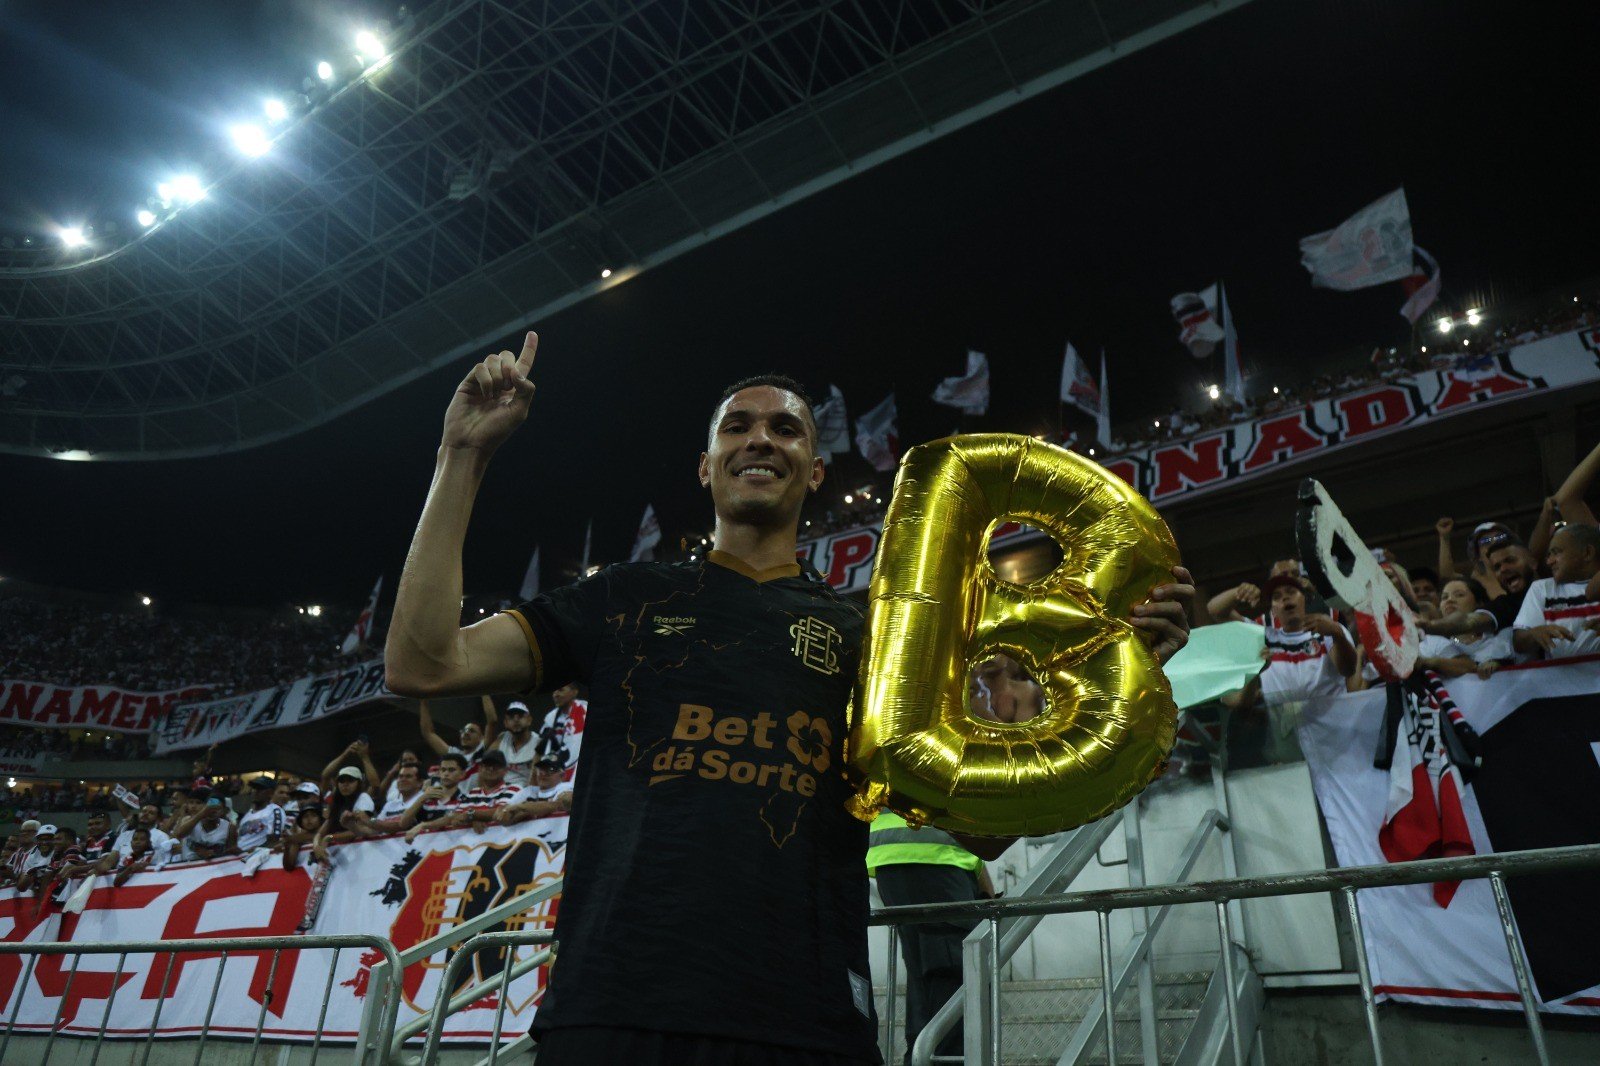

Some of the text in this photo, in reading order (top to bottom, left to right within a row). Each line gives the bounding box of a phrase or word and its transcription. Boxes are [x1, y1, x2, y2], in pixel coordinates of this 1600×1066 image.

[653, 615, 697, 625] Reebok
[0, 683, 214, 729] NAMEN
[297, 664, 391, 720] TOR
[671, 703, 778, 750] Bet
[652, 745, 817, 798] dá Sorte
[0, 866, 312, 1029] ÇA
